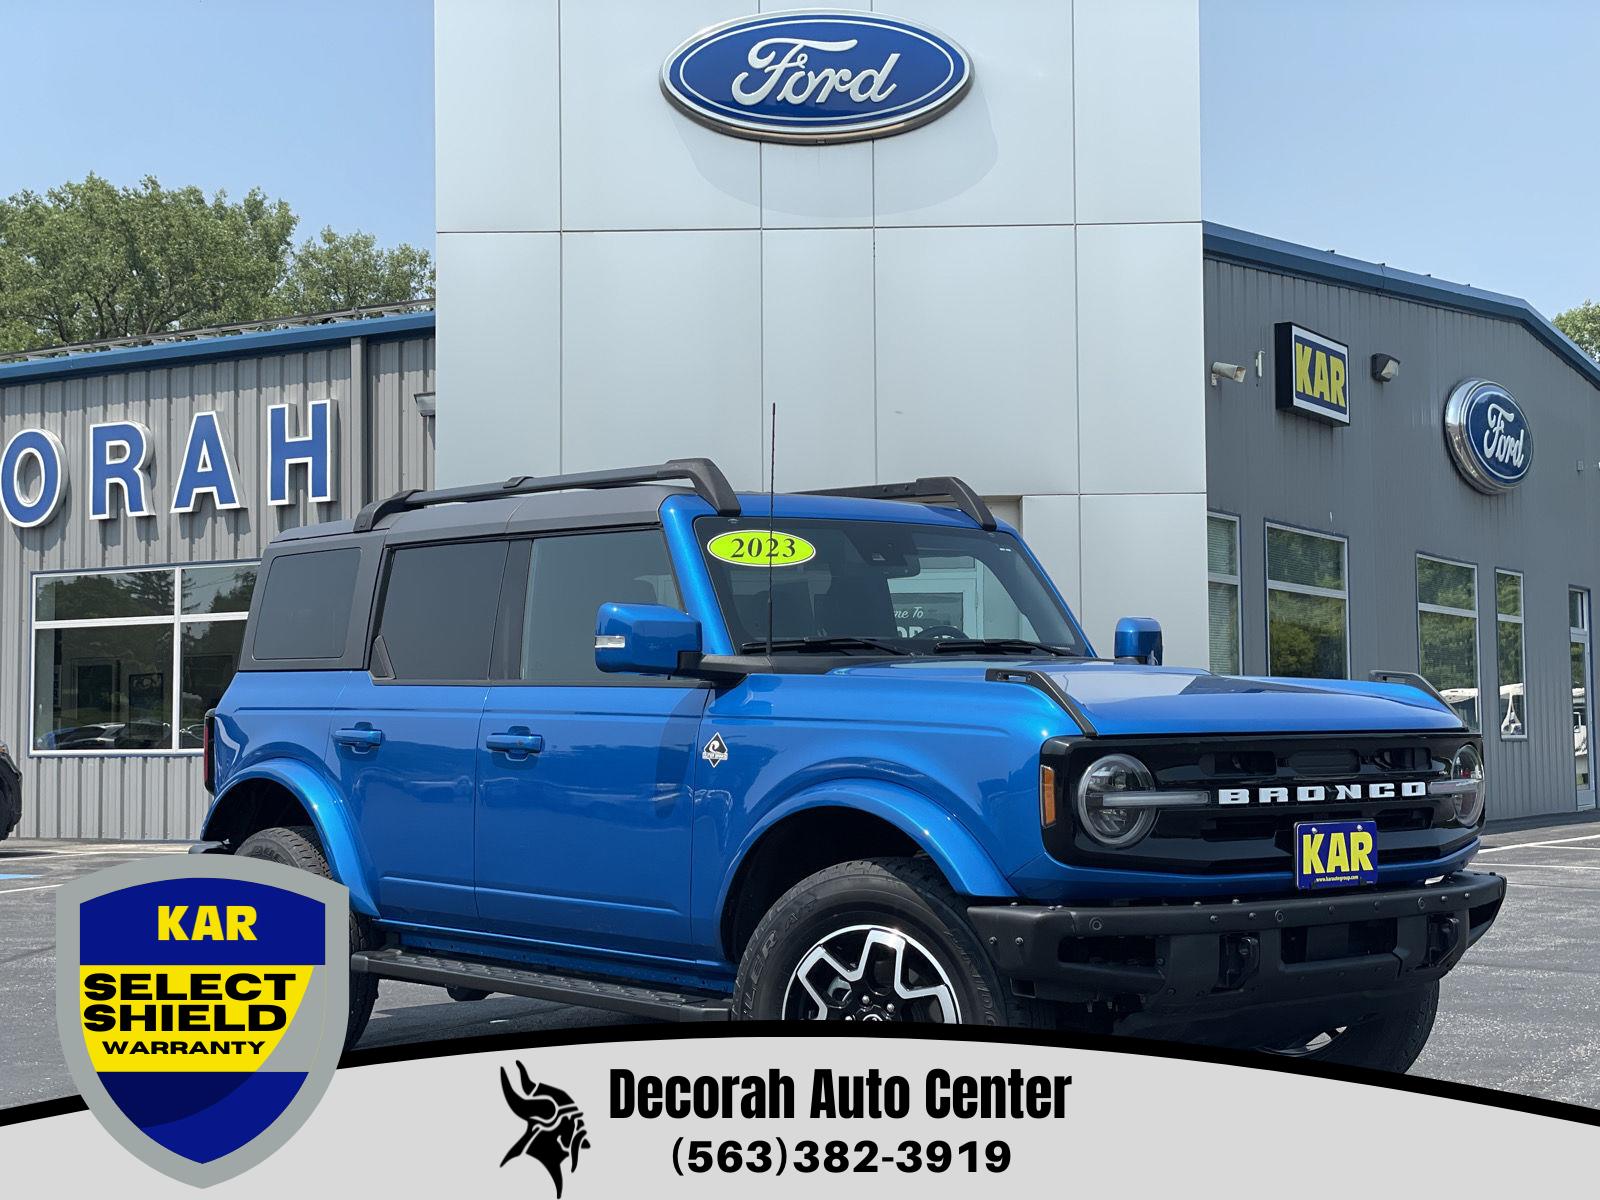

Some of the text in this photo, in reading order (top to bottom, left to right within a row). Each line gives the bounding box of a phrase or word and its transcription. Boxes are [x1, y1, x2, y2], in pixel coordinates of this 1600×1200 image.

[731, 37, 901, 106] Ford
[1295, 342, 1346, 407] KAR
[1483, 403, 1525, 468] Ford
[0, 398, 336, 528] ORAH
[731, 538, 796, 558] 2023
[912, 606, 924, 619] To
[1218, 781, 1427, 805] BRONCO
[1303, 831, 1374, 875] KAR
